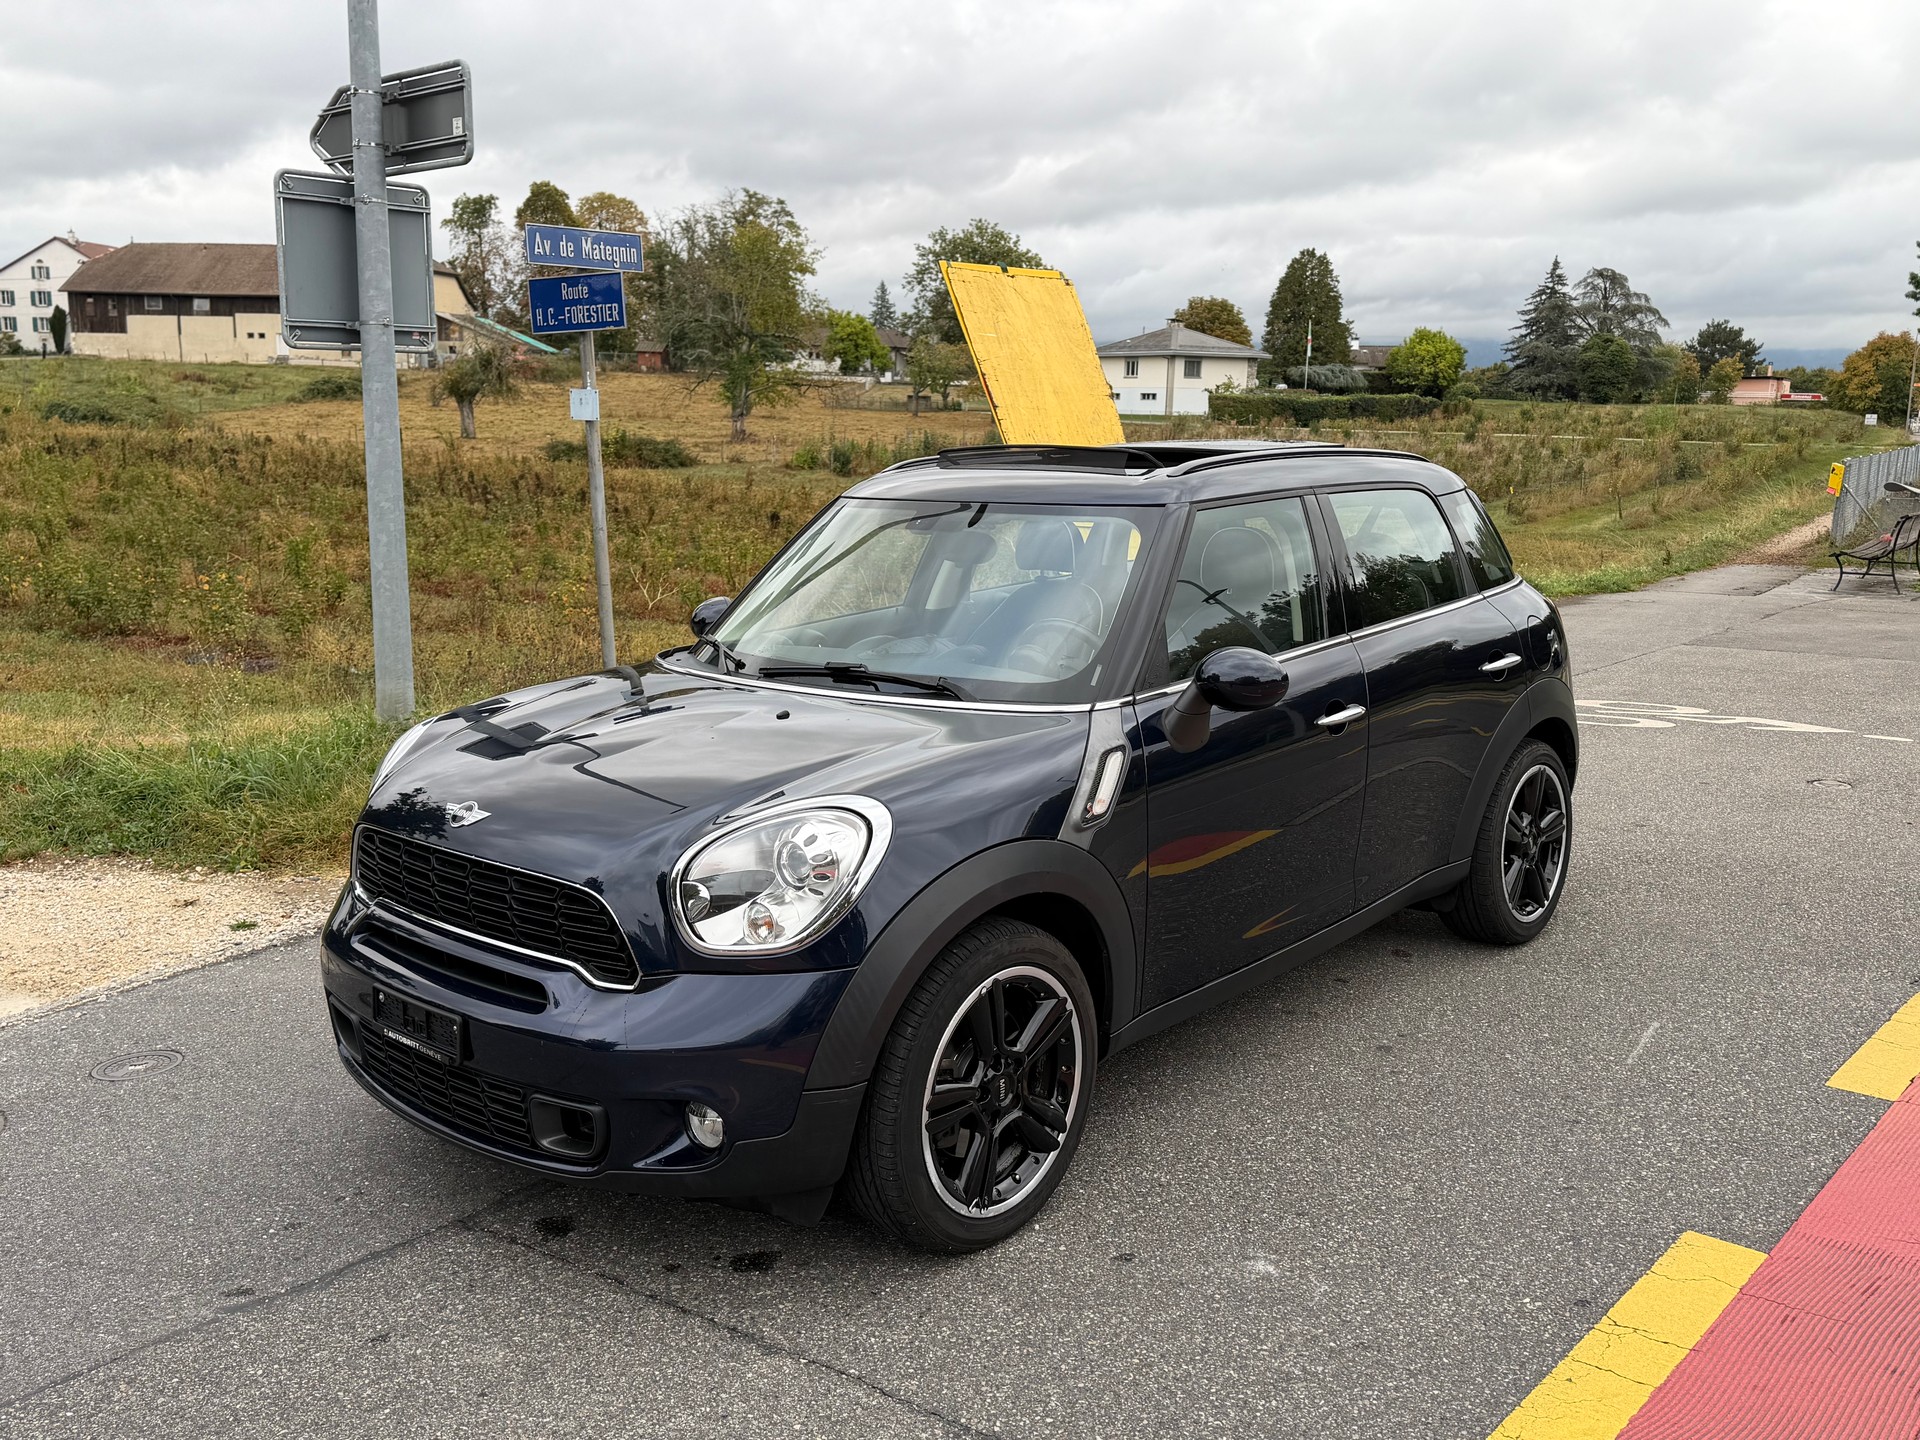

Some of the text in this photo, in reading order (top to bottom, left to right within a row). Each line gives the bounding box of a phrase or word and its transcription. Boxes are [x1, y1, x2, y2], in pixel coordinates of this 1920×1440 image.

[534, 232, 638, 268] Av. de Mategnin
[561, 282, 589, 300] Route
[536, 303, 619, 326] H.C.-FORESTIER
[388, 1030, 419, 1050] AUTOBRITT
